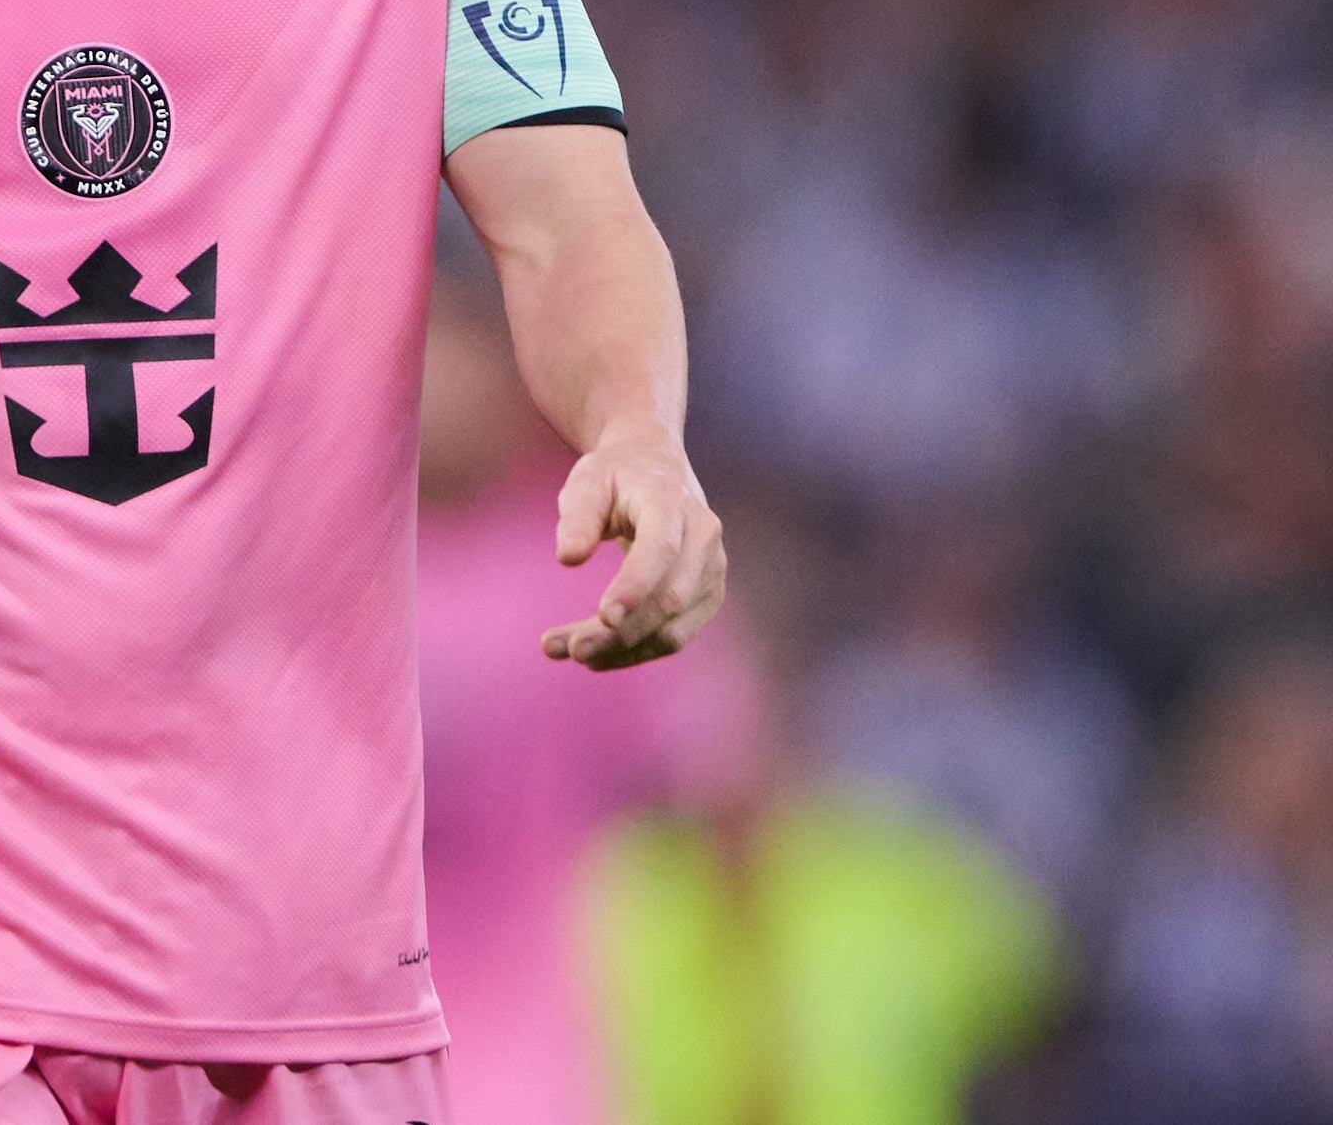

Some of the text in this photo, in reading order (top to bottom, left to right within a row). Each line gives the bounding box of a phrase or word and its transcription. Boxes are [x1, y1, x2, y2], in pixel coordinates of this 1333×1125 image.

[25, 50, 138, 119] INTERNACIONAL
[65, 85, 123, 100] MIAMI
[140, 75, 159, 95] DE
[25, 126, 50, 168] CLUB
[77, 178, 126, 195] MMXX
